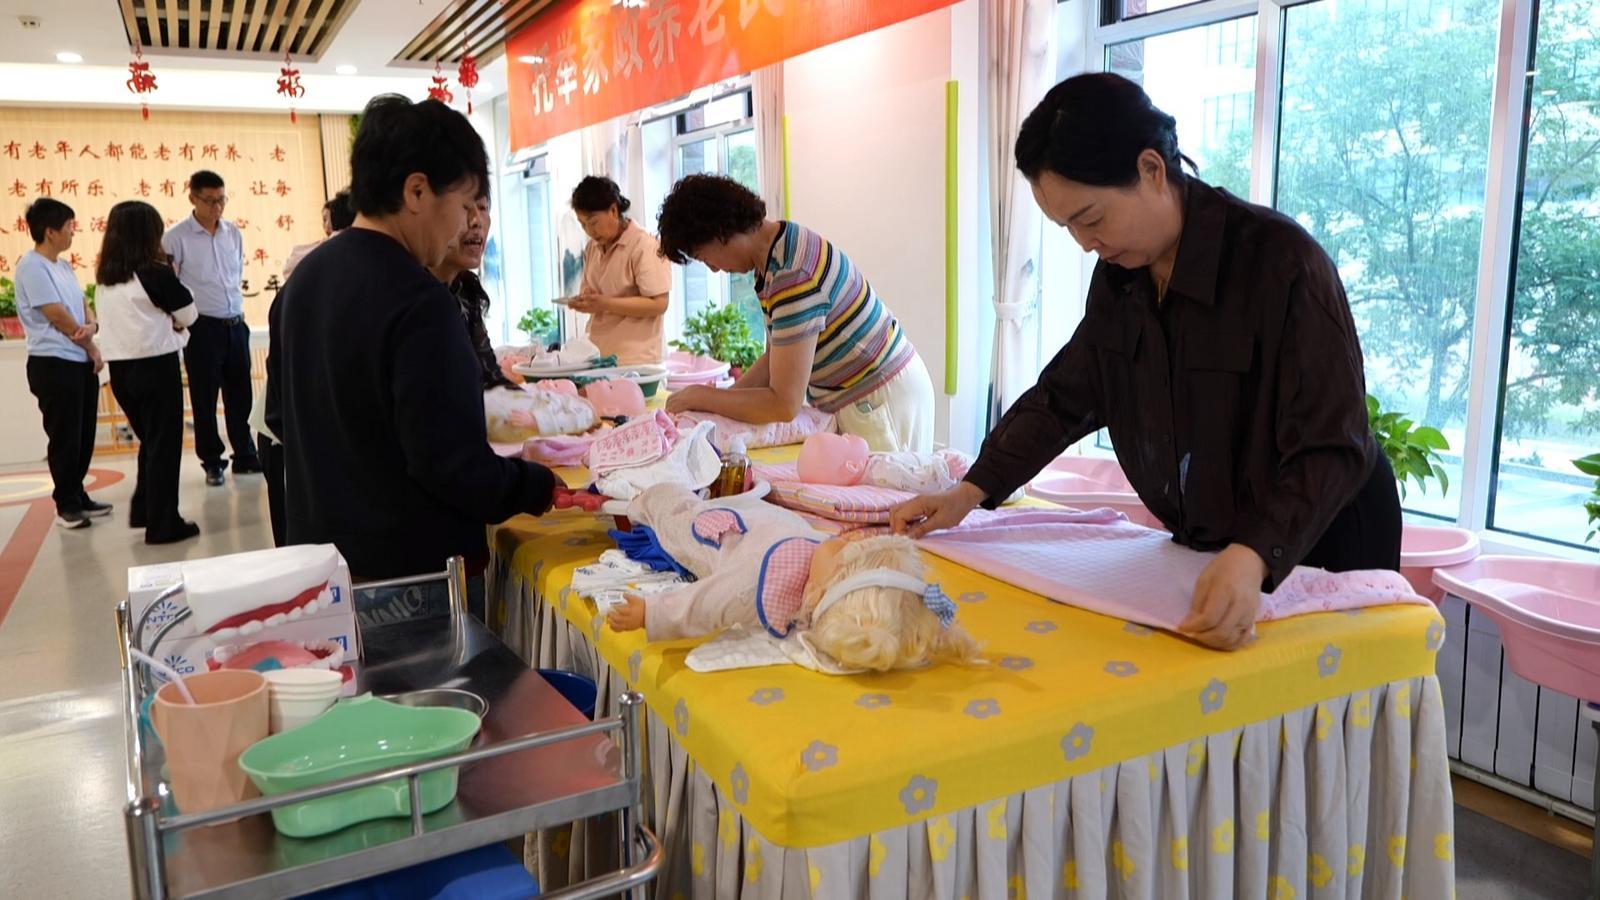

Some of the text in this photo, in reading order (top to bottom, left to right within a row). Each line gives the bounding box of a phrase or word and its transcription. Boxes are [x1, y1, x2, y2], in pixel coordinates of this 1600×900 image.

[4, 140, 287, 162] 有老年人都能老有所养、老
